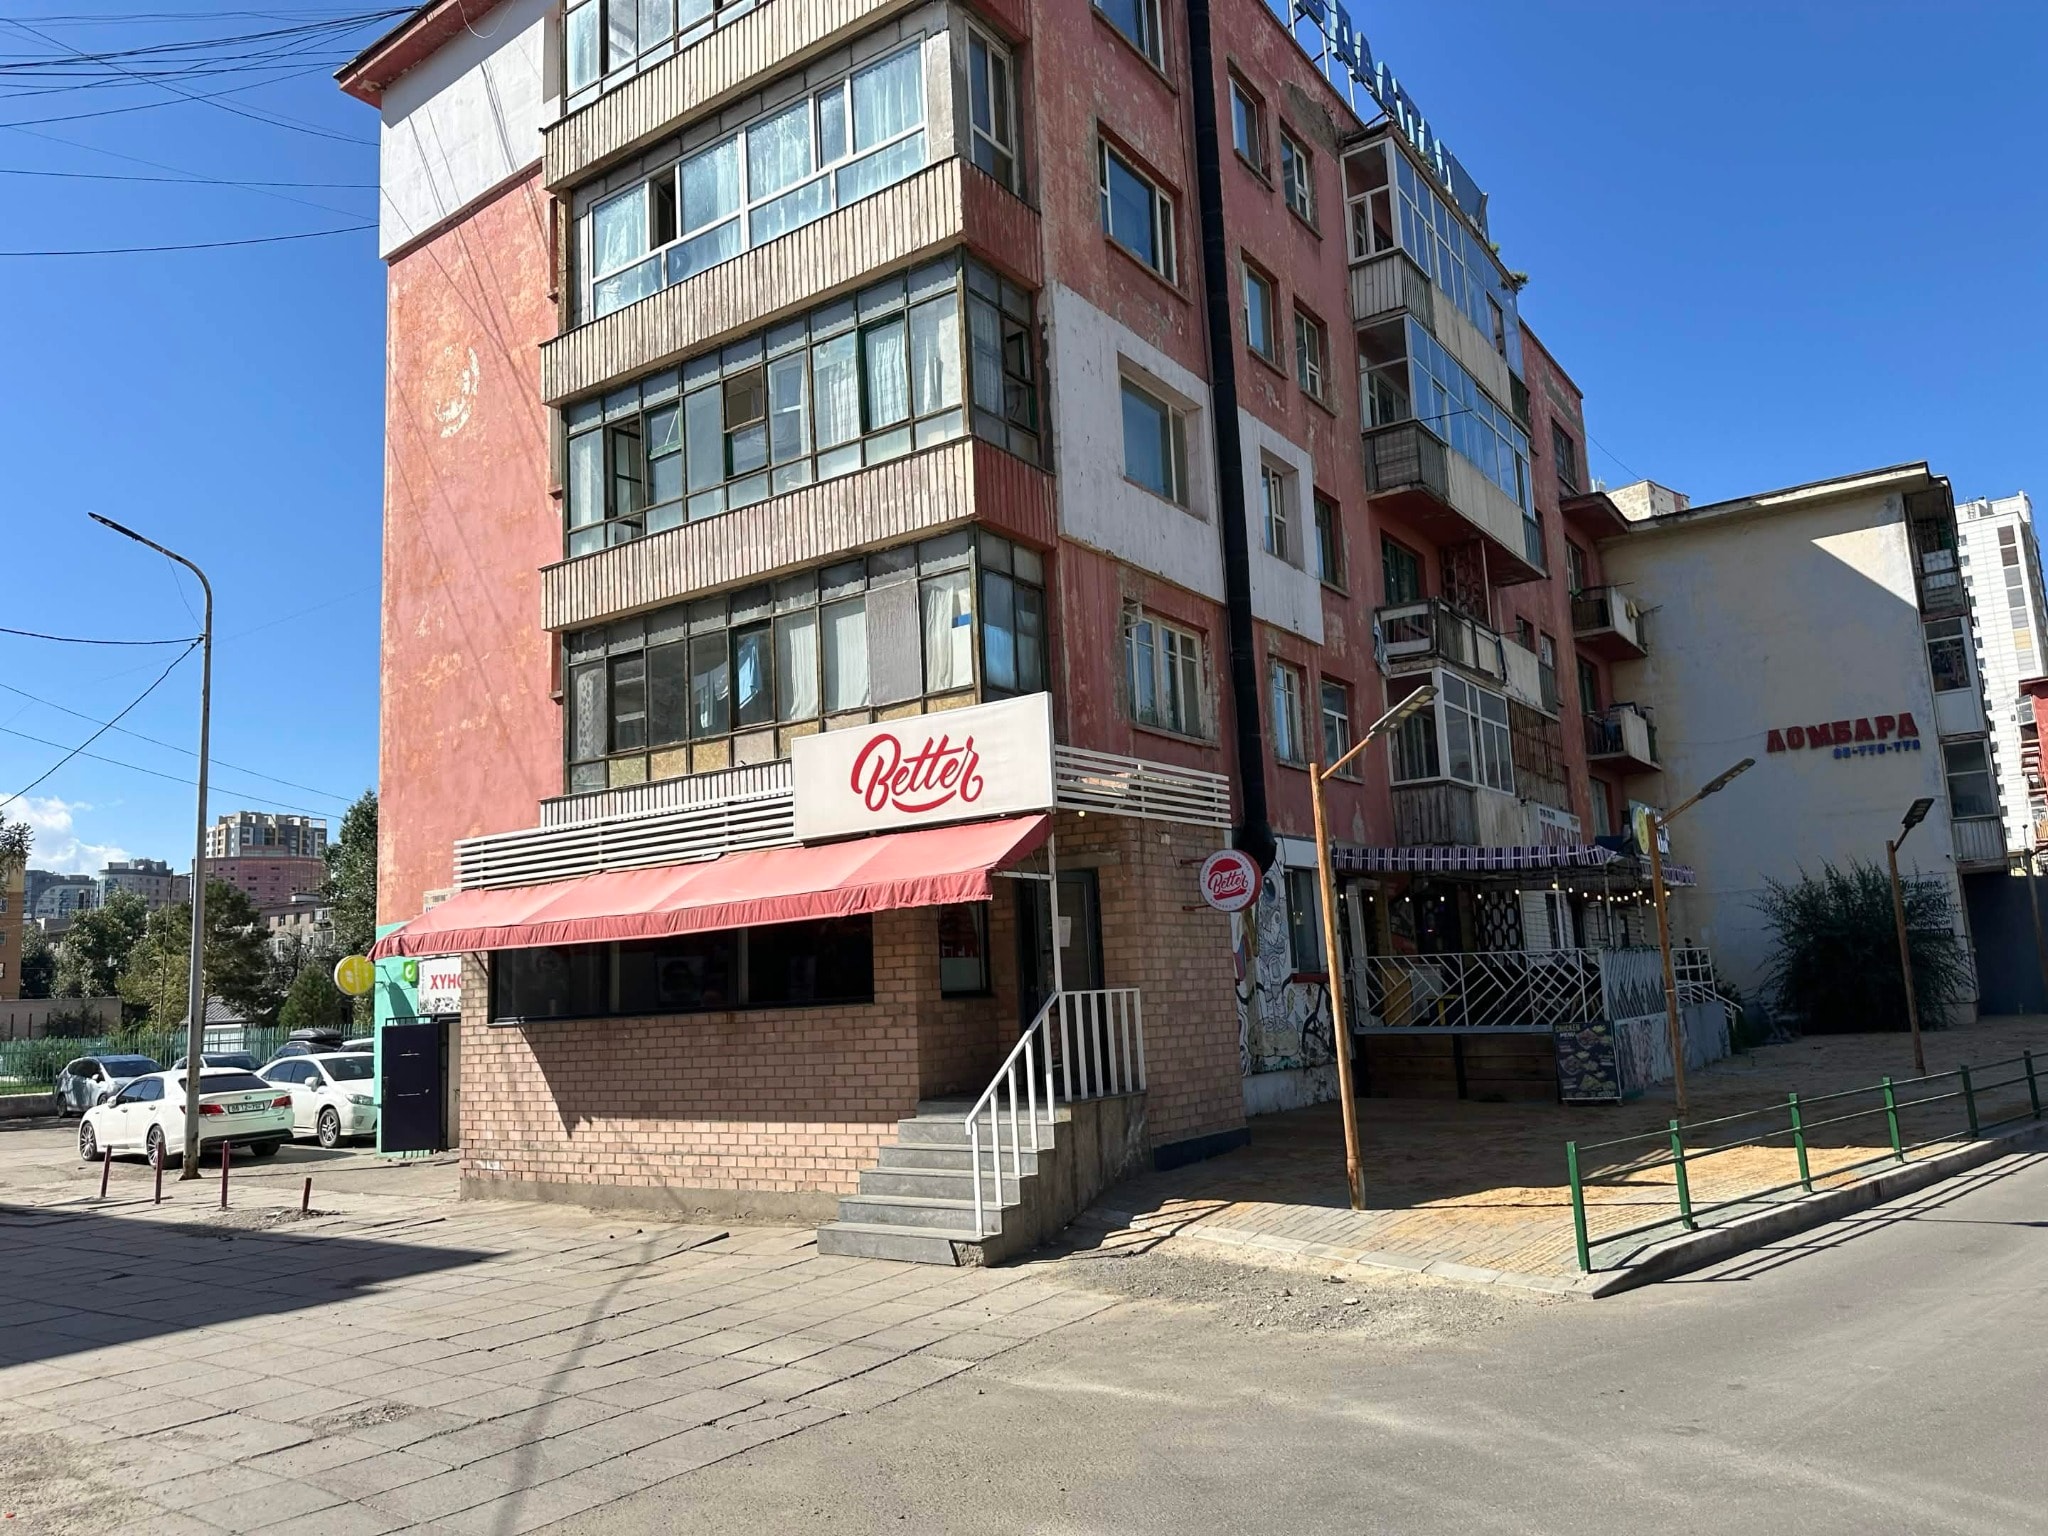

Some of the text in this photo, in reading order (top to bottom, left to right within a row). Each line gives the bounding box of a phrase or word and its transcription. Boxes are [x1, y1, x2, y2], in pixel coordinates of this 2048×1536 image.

[1767, 712, 1919, 753] ЛОМБАРД
[851, 733, 983, 812] Better
[1208, 870, 1249, 894] Better
